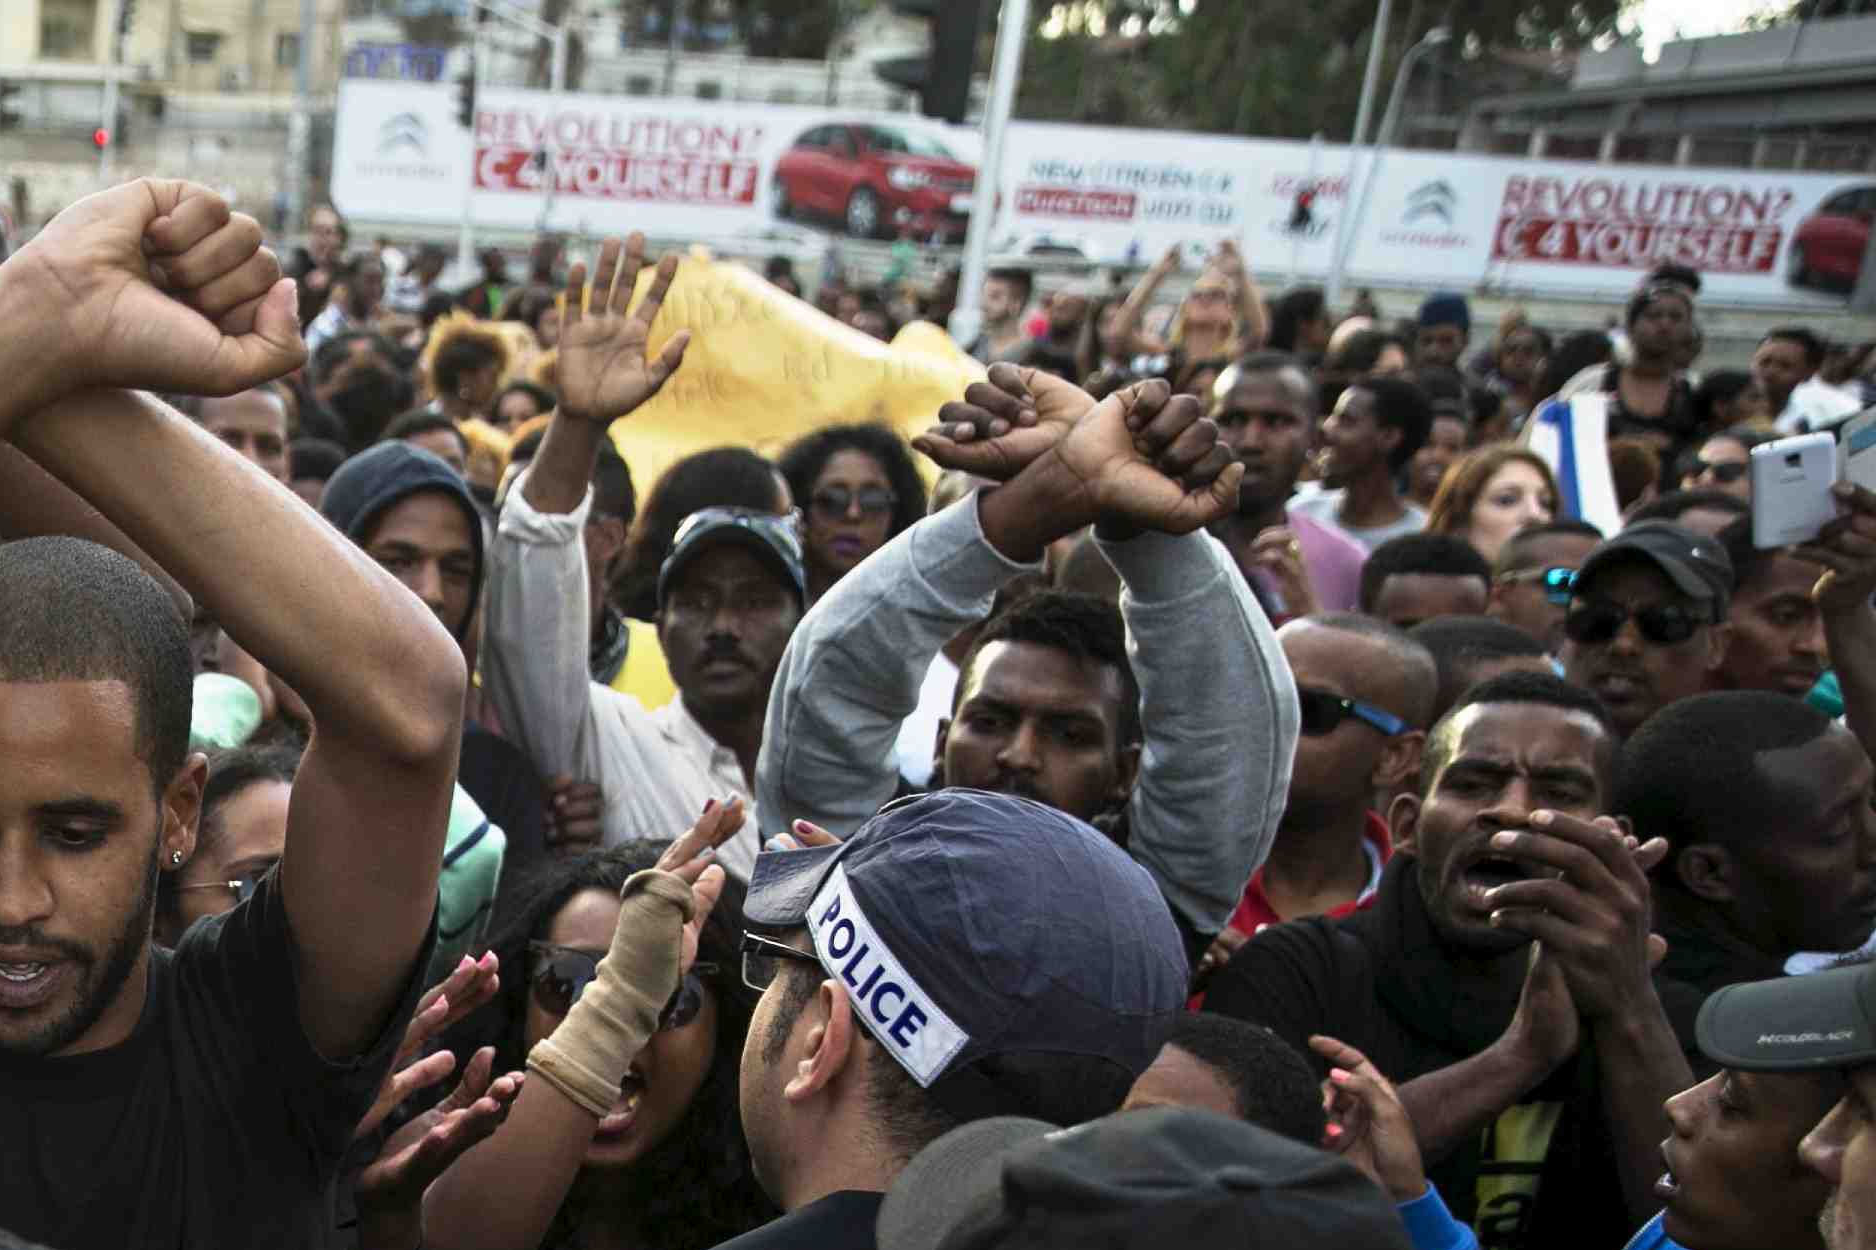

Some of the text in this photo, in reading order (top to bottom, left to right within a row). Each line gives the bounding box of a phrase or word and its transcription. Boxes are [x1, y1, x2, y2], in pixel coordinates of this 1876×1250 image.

[476, 111, 764, 153] REVOLUTION?
[480, 148, 512, 189] C
[552, 152, 758, 203] YOURSELF
[1502, 175, 1792, 227] REVOLUTION?
[1502, 217, 1776, 267] C 4 YOURSELF
[818, 893, 928, 1049] POLICE
